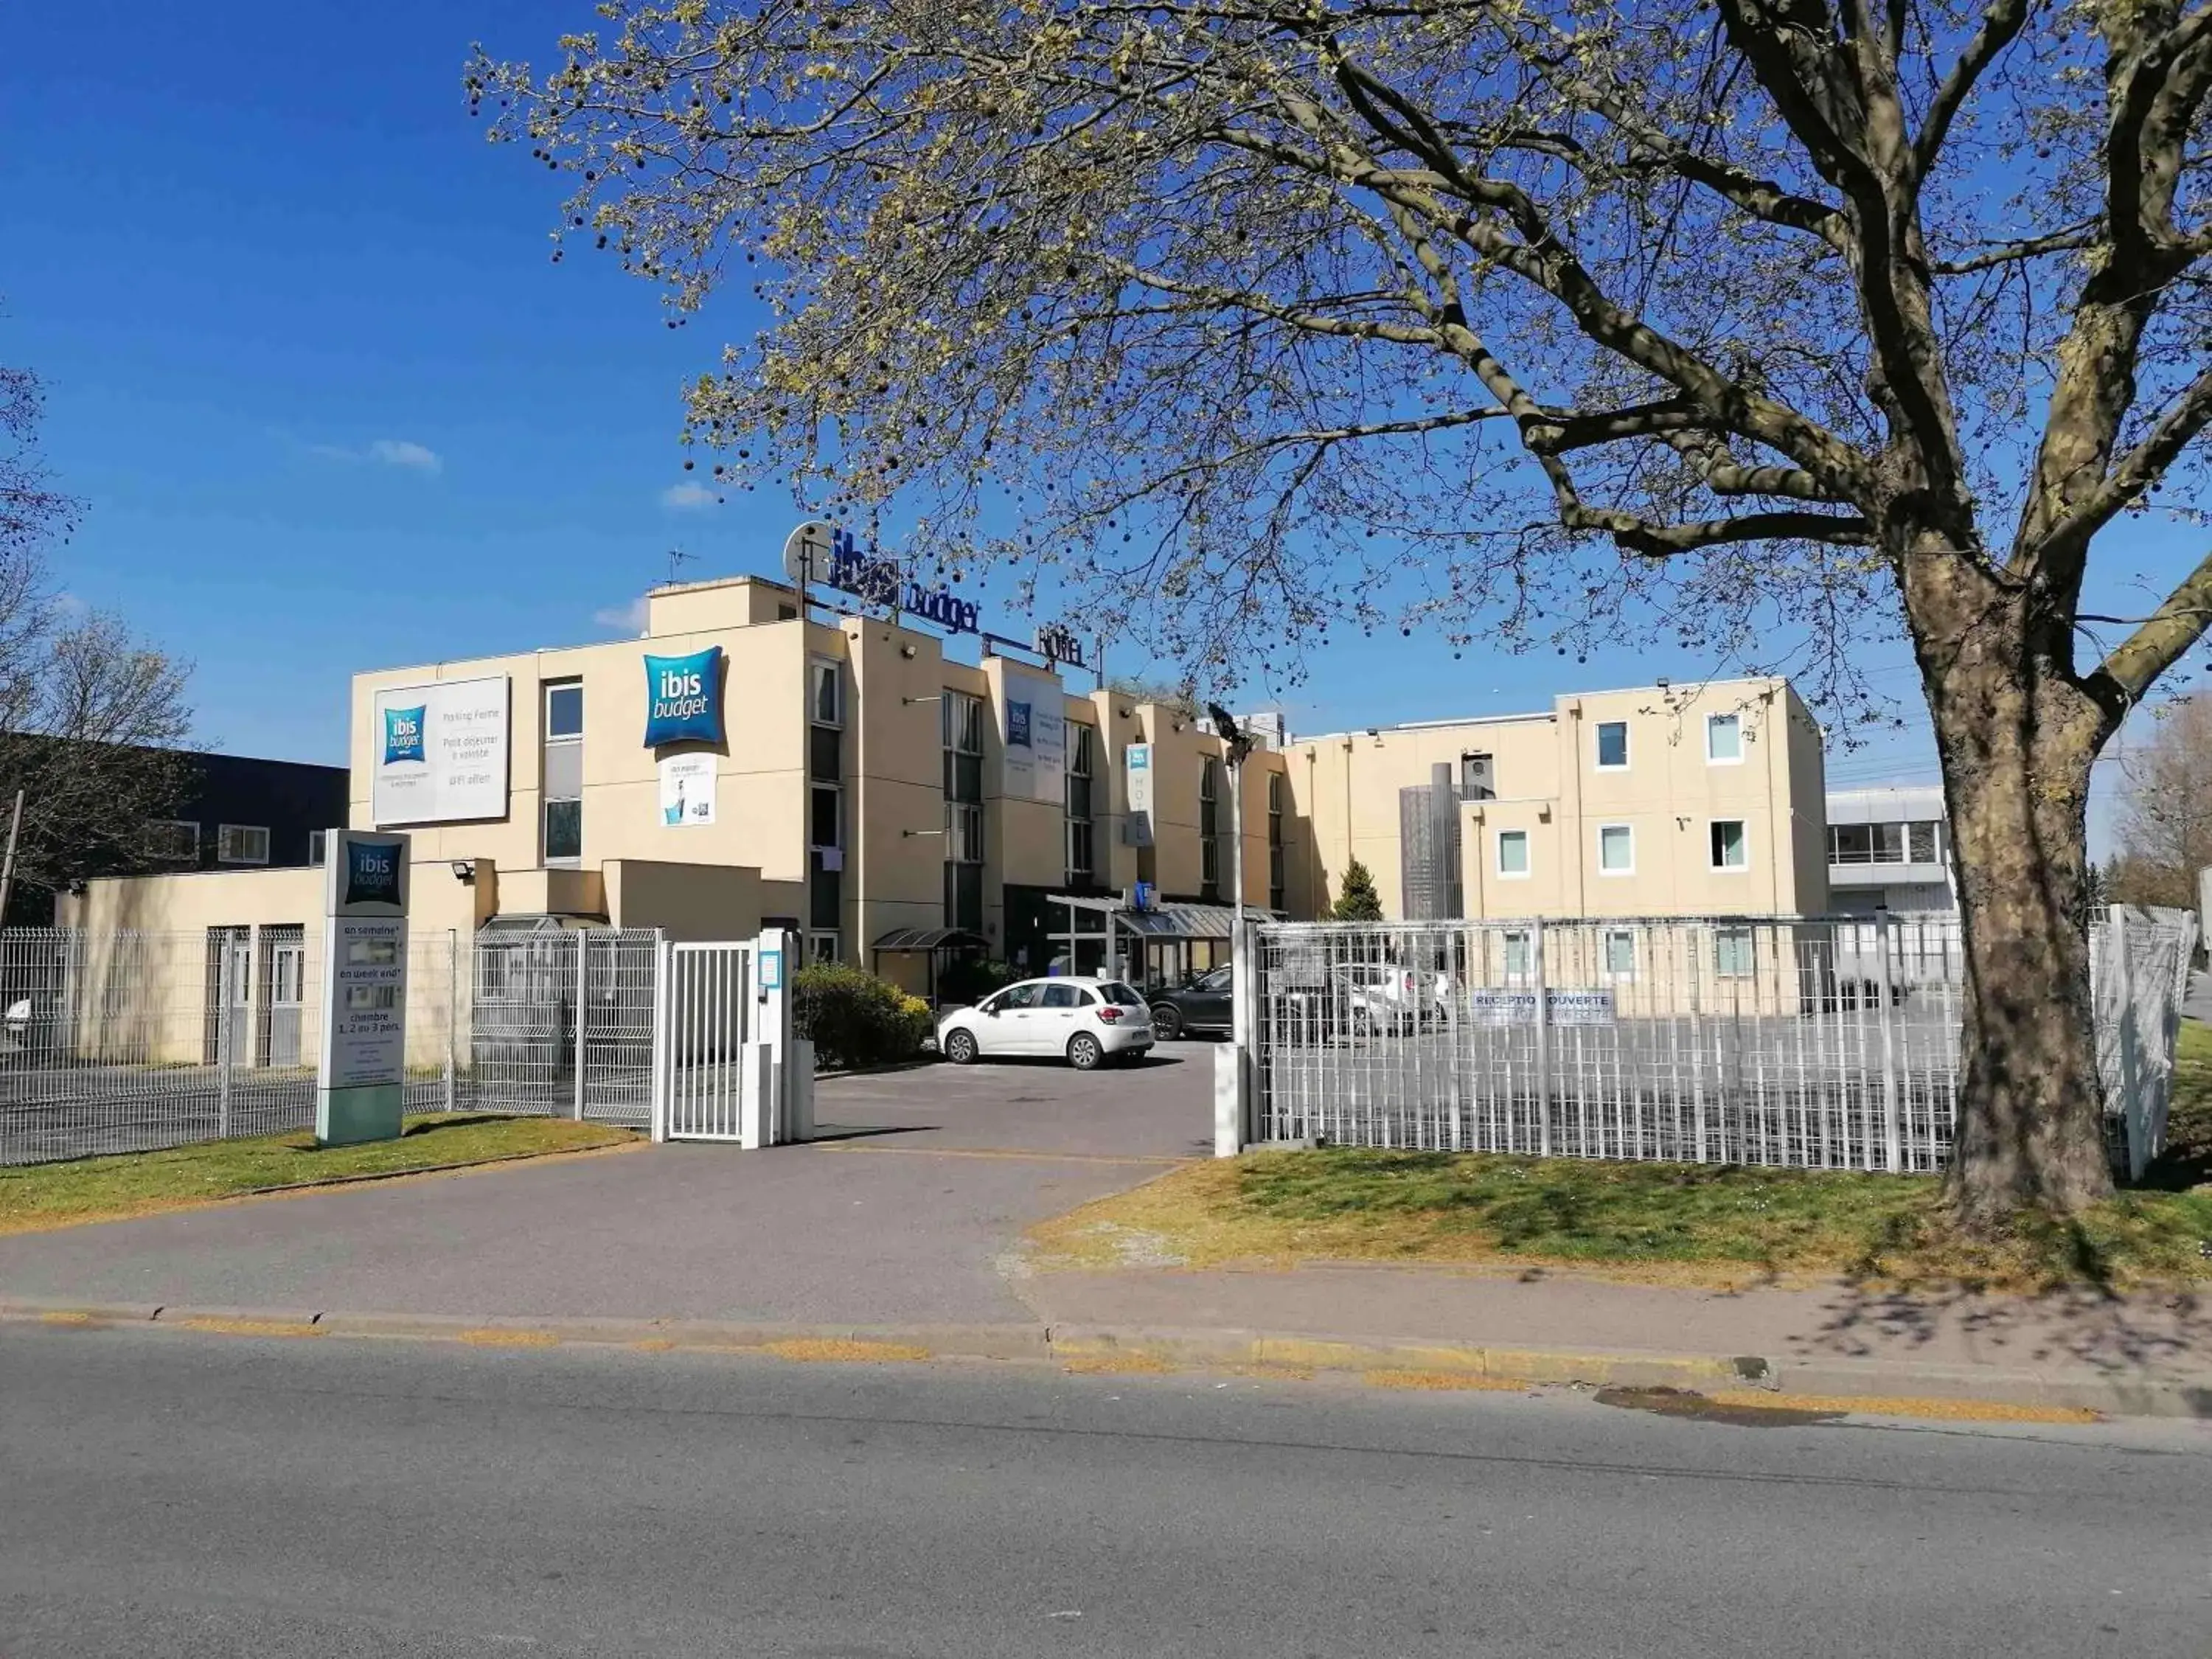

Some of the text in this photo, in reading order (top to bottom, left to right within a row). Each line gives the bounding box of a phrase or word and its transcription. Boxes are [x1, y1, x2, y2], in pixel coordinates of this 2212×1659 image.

[661, 669, 701, 698] ibis
[654, 696, 709, 720] budget
[393, 717, 417, 736] ibis
[390, 734, 420, 748] budget
[361, 854, 390, 873] ibis
[355, 872, 393, 887] budget
[354, 969, 378, 978] week
[1548, 997, 1609, 1006] OUVERTE
[350, 1012, 389, 1022] chambre
[372, 1023, 378, 1032] 3
